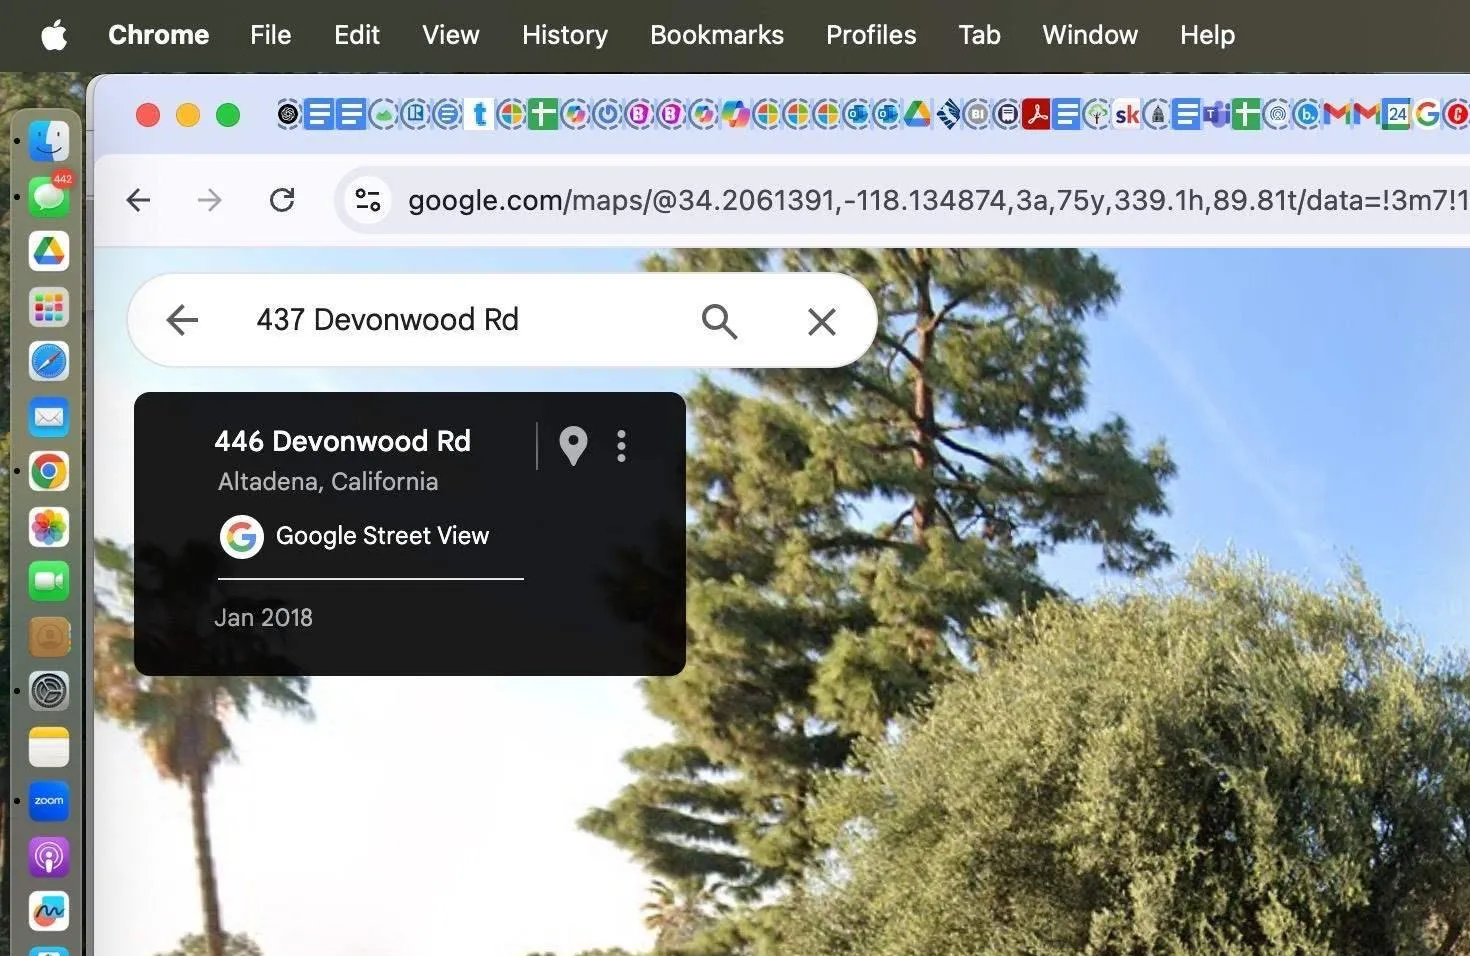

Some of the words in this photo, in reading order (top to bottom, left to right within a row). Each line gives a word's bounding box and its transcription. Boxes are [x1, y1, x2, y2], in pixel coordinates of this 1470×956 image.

[108, 23, 210, 46] Chrome
[251, 23, 292, 45] File
[335, 23, 381, 46] Edit
[422, 23, 481, 45] View
[523, 23, 609, 50] History
[651, 23, 785, 46] Bookmarks
[827, 23, 917, 46] Profiles
[958, 23, 1002, 45] Tab
[1042, 23, 1139, 46] Window
[1181, 23, 1236, 50] Help
[1115, 104, 1139, 124] sk
[1389, 106, 1407, 122] 24
[53, 173, 73, 184] 442
[256, 307, 305, 332] 437
[315, 305, 475, 332] Devonwood
[485, 305, 519, 332] Rd
[214, 429, 265, 453] 446
[273, 428, 428, 453] Devonwood
[437, 428, 471, 453] Rd
[217, 470, 324, 494] Altadena,
[331, 470, 439, 492] California
[276, 524, 357, 551] Google
[363, 525, 432, 546] Street
[436, 524, 490, 546] View
[213, 607, 254, 628] Jan
[261, 607, 313, 628] 2018
[34, 797, 64, 805] zoom
